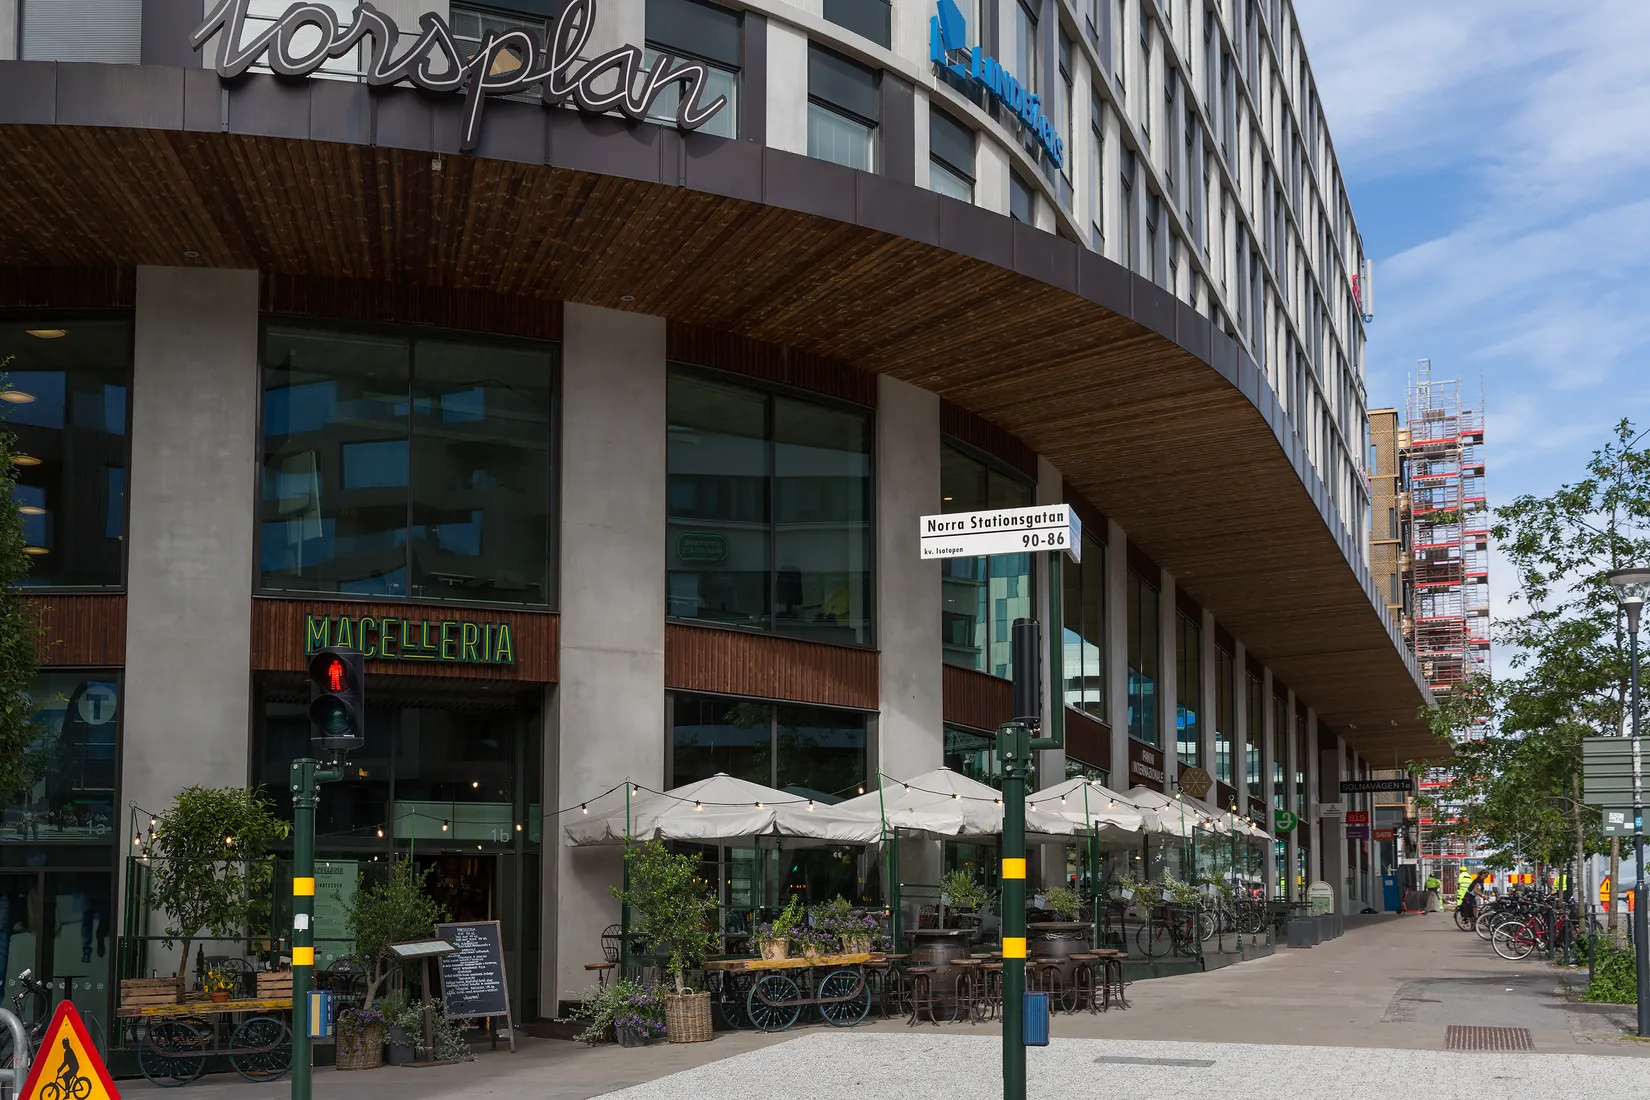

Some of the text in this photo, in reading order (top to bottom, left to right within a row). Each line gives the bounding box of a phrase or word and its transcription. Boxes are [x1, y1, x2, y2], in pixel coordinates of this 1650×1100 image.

[927, 512, 1064, 532] Norra Stationsgatan
[1022, 531, 1065, 548] 90-86
[936, 547, 964, 555] Isotopen
[304, 613, 515, 665] MACELLERIA
[1342, 781, 1400, 791] SOLNAVÄGEN
[86, 819, 106, 835] 1a
[490, 828, 510, 843] 1b
